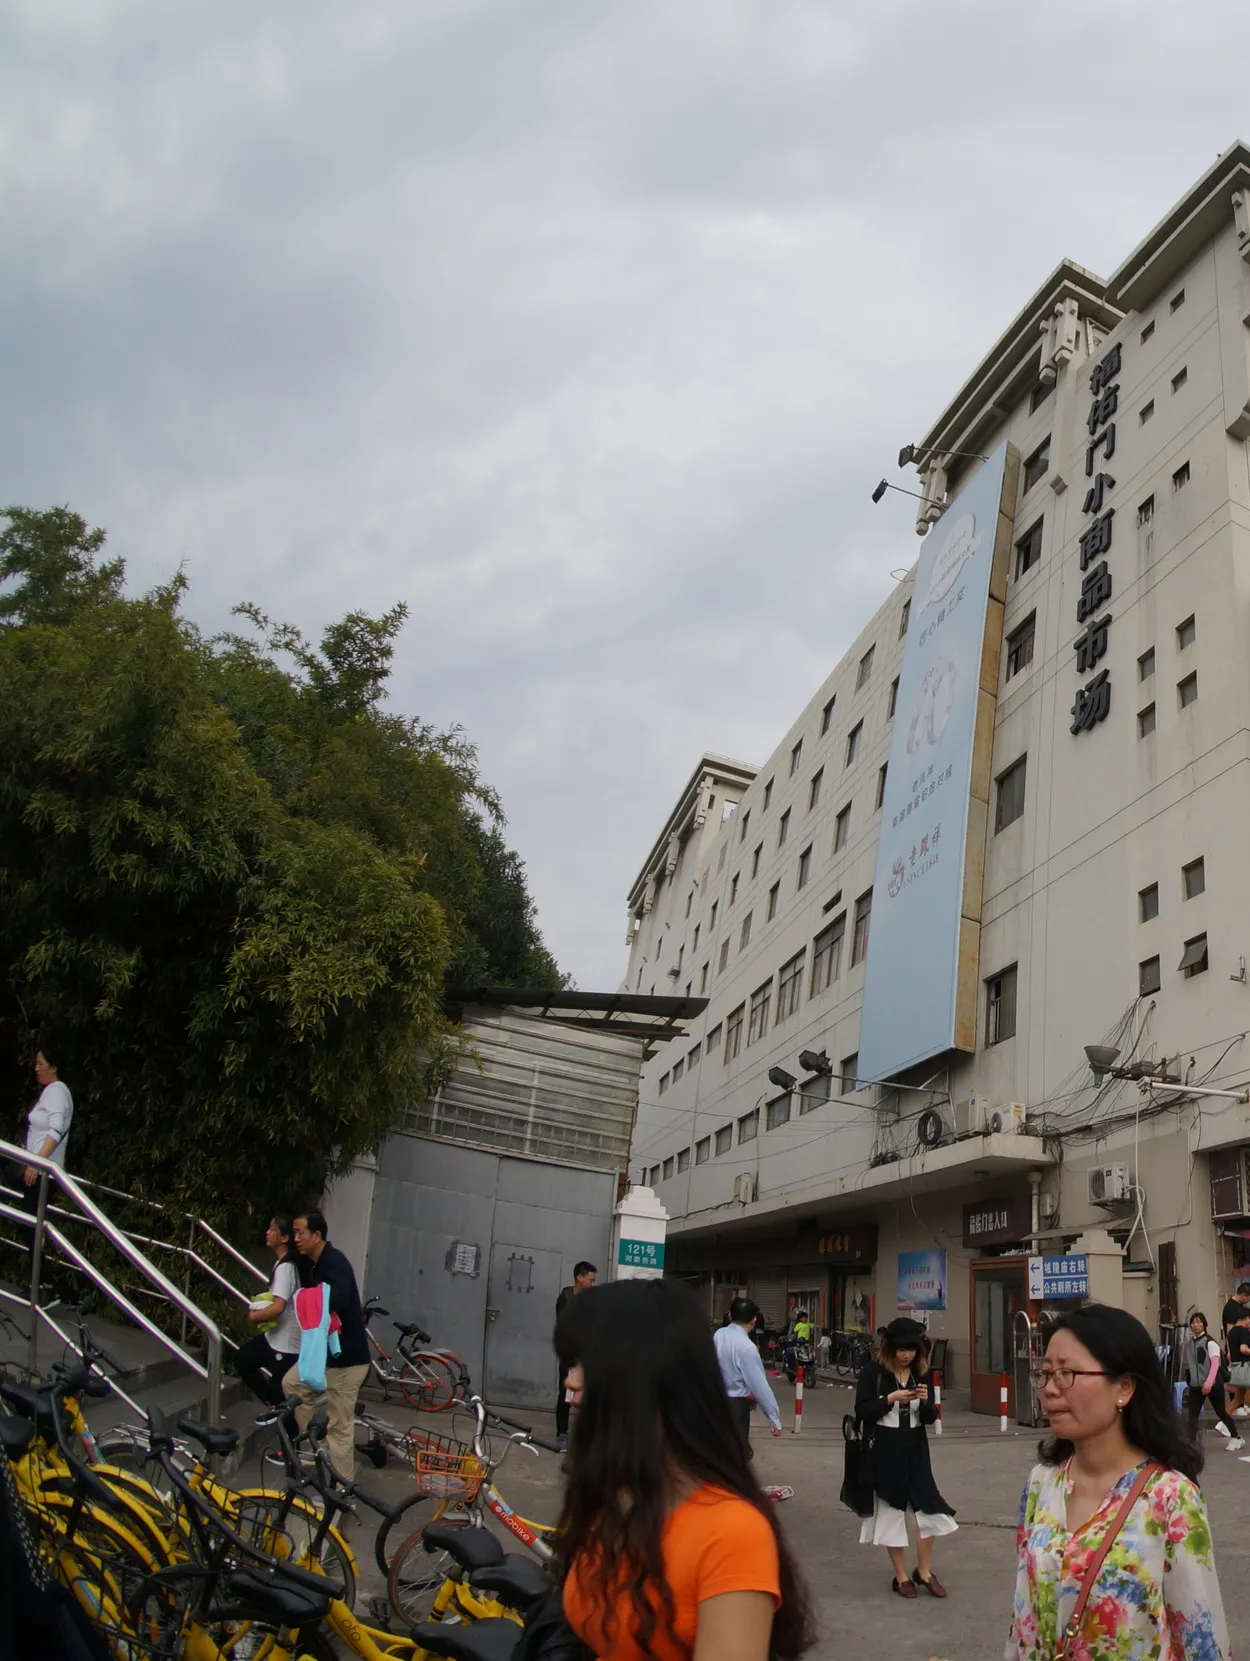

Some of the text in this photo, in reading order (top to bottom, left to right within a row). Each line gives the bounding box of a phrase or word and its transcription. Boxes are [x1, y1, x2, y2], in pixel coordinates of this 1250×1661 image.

[1070, 342, 1122, 735] 福佑门小商品市场
[969, 1210, 1008, 1236] 福佑门出入口
[627, 1243, 656, 1257] 121号
[1044, 1260, 1086, 1275] 城隍庙右转
[1043, 1280, 1087, 1295] 公共厕所左转
[500, 1511, 530, 1541] mobike
[342, 1618, 361, 1641] ofo
